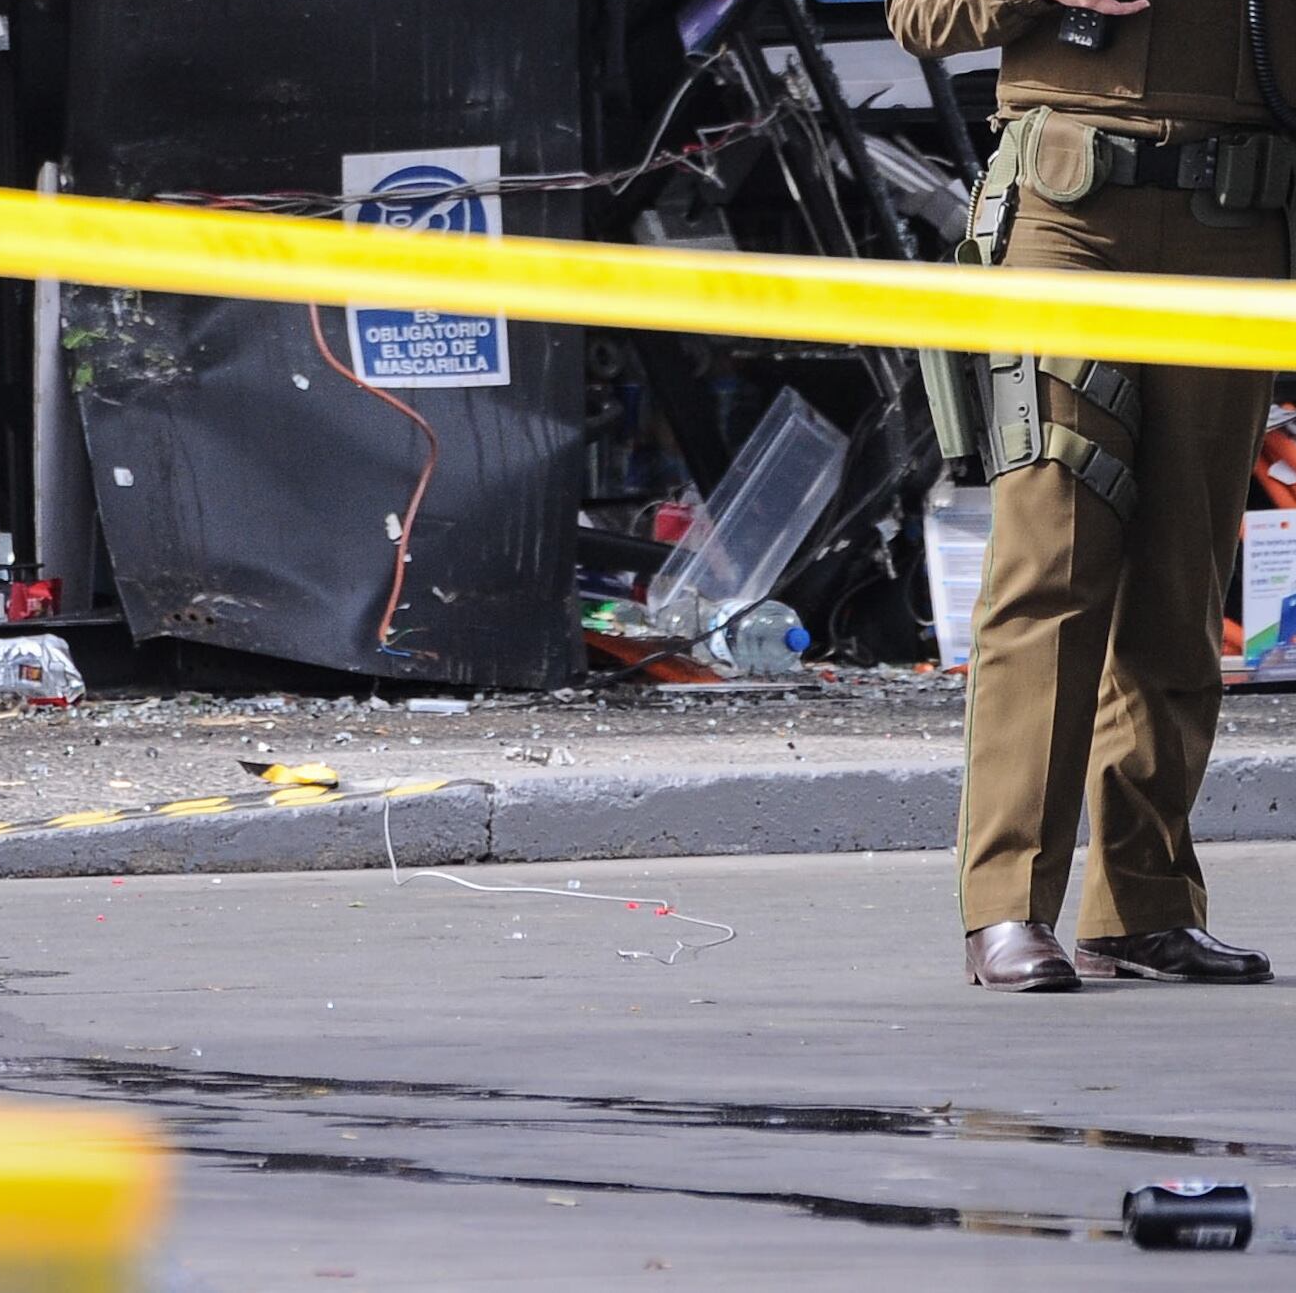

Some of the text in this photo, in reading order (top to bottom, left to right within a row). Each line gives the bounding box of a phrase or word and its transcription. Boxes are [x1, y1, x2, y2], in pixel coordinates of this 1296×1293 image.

[413, 309, 439, 323] ES
[365, 321, 491, 344] OBLIGATORIO
[381, 339, 478, 359] EL USO DE
[374, 356, 490, 376] MASCARILLA
